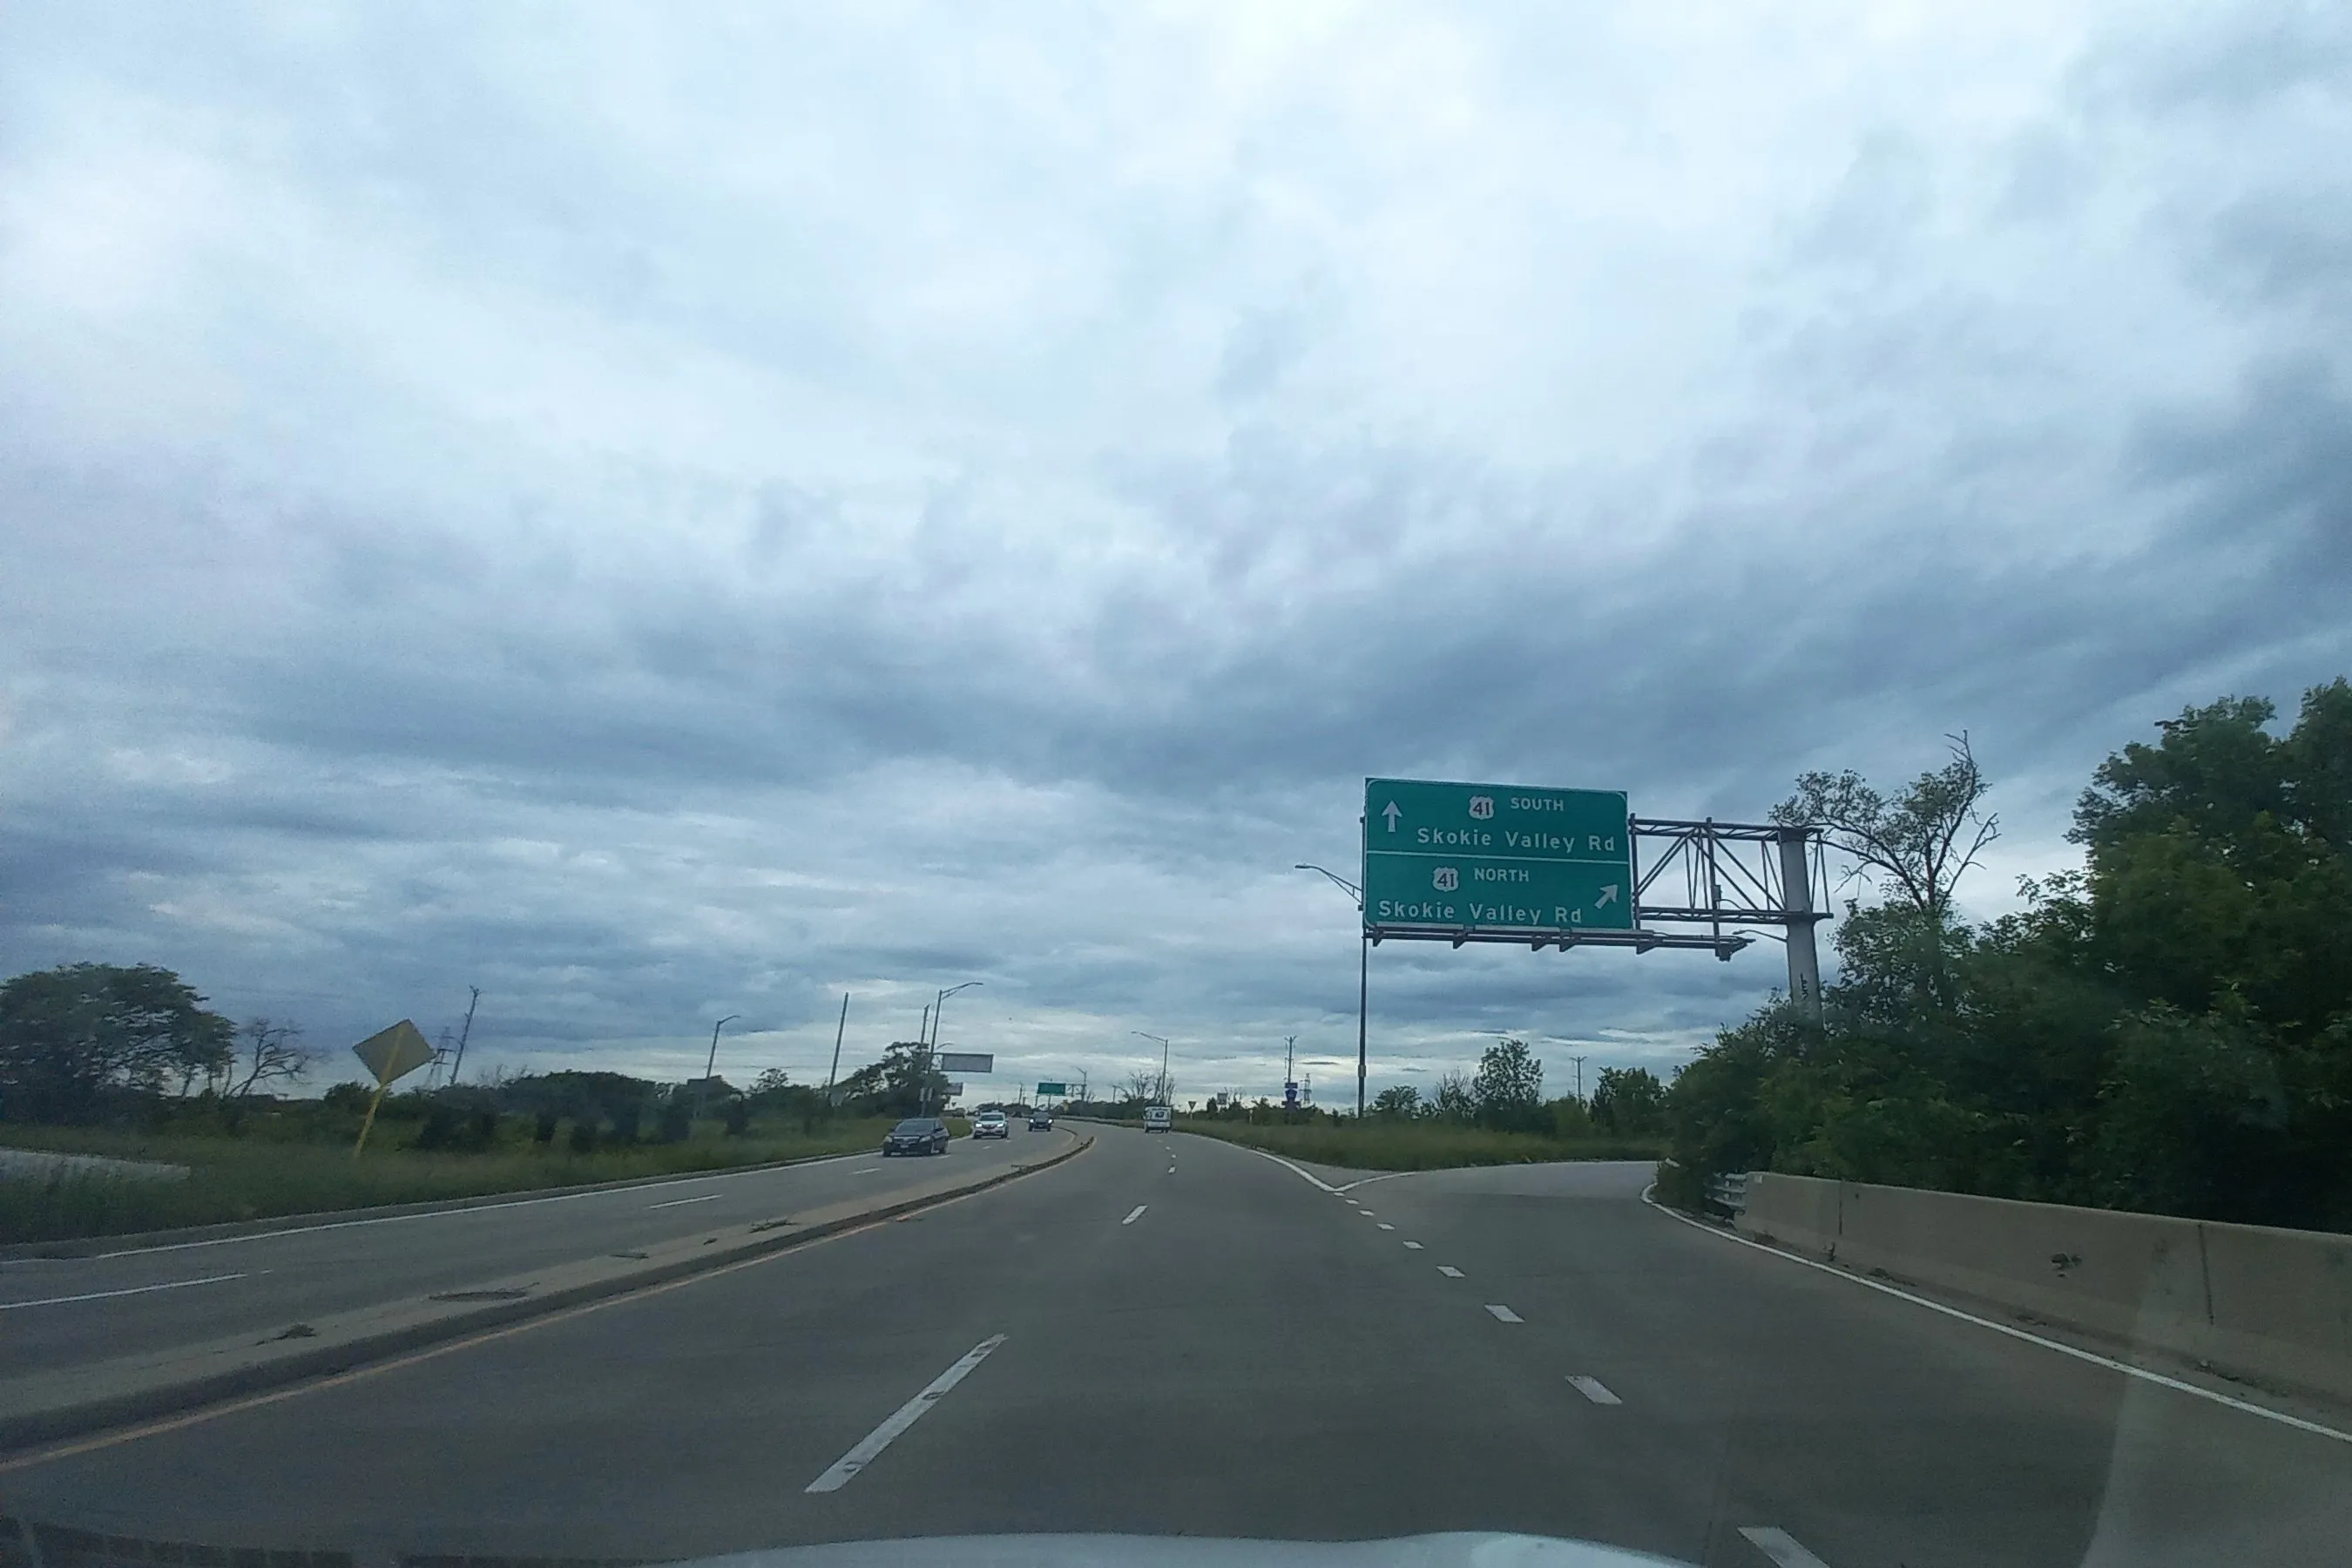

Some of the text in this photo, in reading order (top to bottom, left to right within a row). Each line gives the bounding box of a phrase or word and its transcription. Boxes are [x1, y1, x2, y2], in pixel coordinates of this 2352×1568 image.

[1472, 797, 1565, 816] 41 SOUTH
[1416, 827, 1615, 854] Skokie Valley Rd
[1436, 868, 1530, 889] 41 NORTH
[1378, 900, 1582, 925] Skokie Valley Rd
